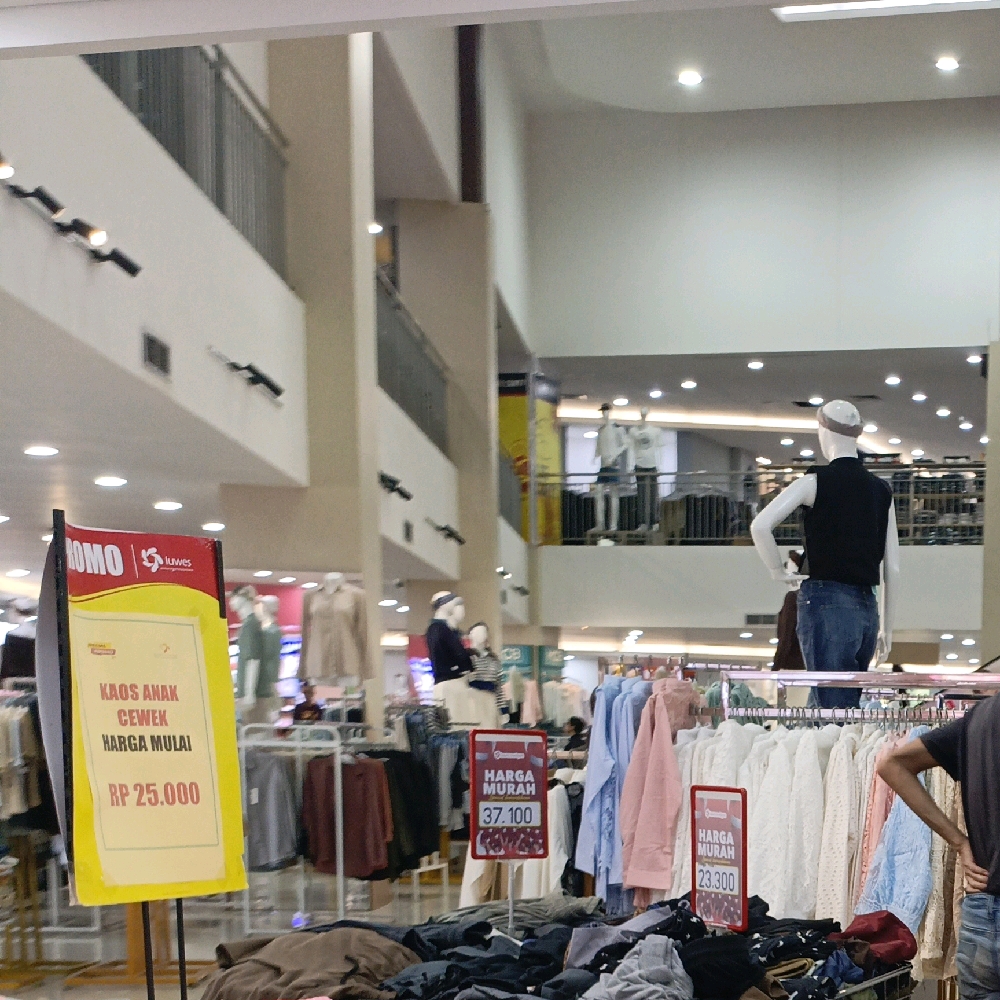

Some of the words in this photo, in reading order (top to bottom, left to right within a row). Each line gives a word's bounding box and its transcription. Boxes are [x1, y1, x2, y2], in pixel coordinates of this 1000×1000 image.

[165, 555, 192, 568] luwes
[100, 683, 139, 701] KAOS
[143, 684, 179, 702] ANAK
[117, 709, 168, 727] CEWEK
[102, 734, 148, 752] HARGA
[150, 735, 192, 752] MULAI
[484, 769, 535, 782] HARGA
[108, 783, 130, 807] RP
[133, 782, 201, 807] 25.000
[483, 783, 536, 795] MURAH
[483, 807, 533, 825] 37.100
[698, 829, 735, 845] HARGA
[697, 843, 735, 860] MURAH
[698, 869, 735, 892] 23.300
